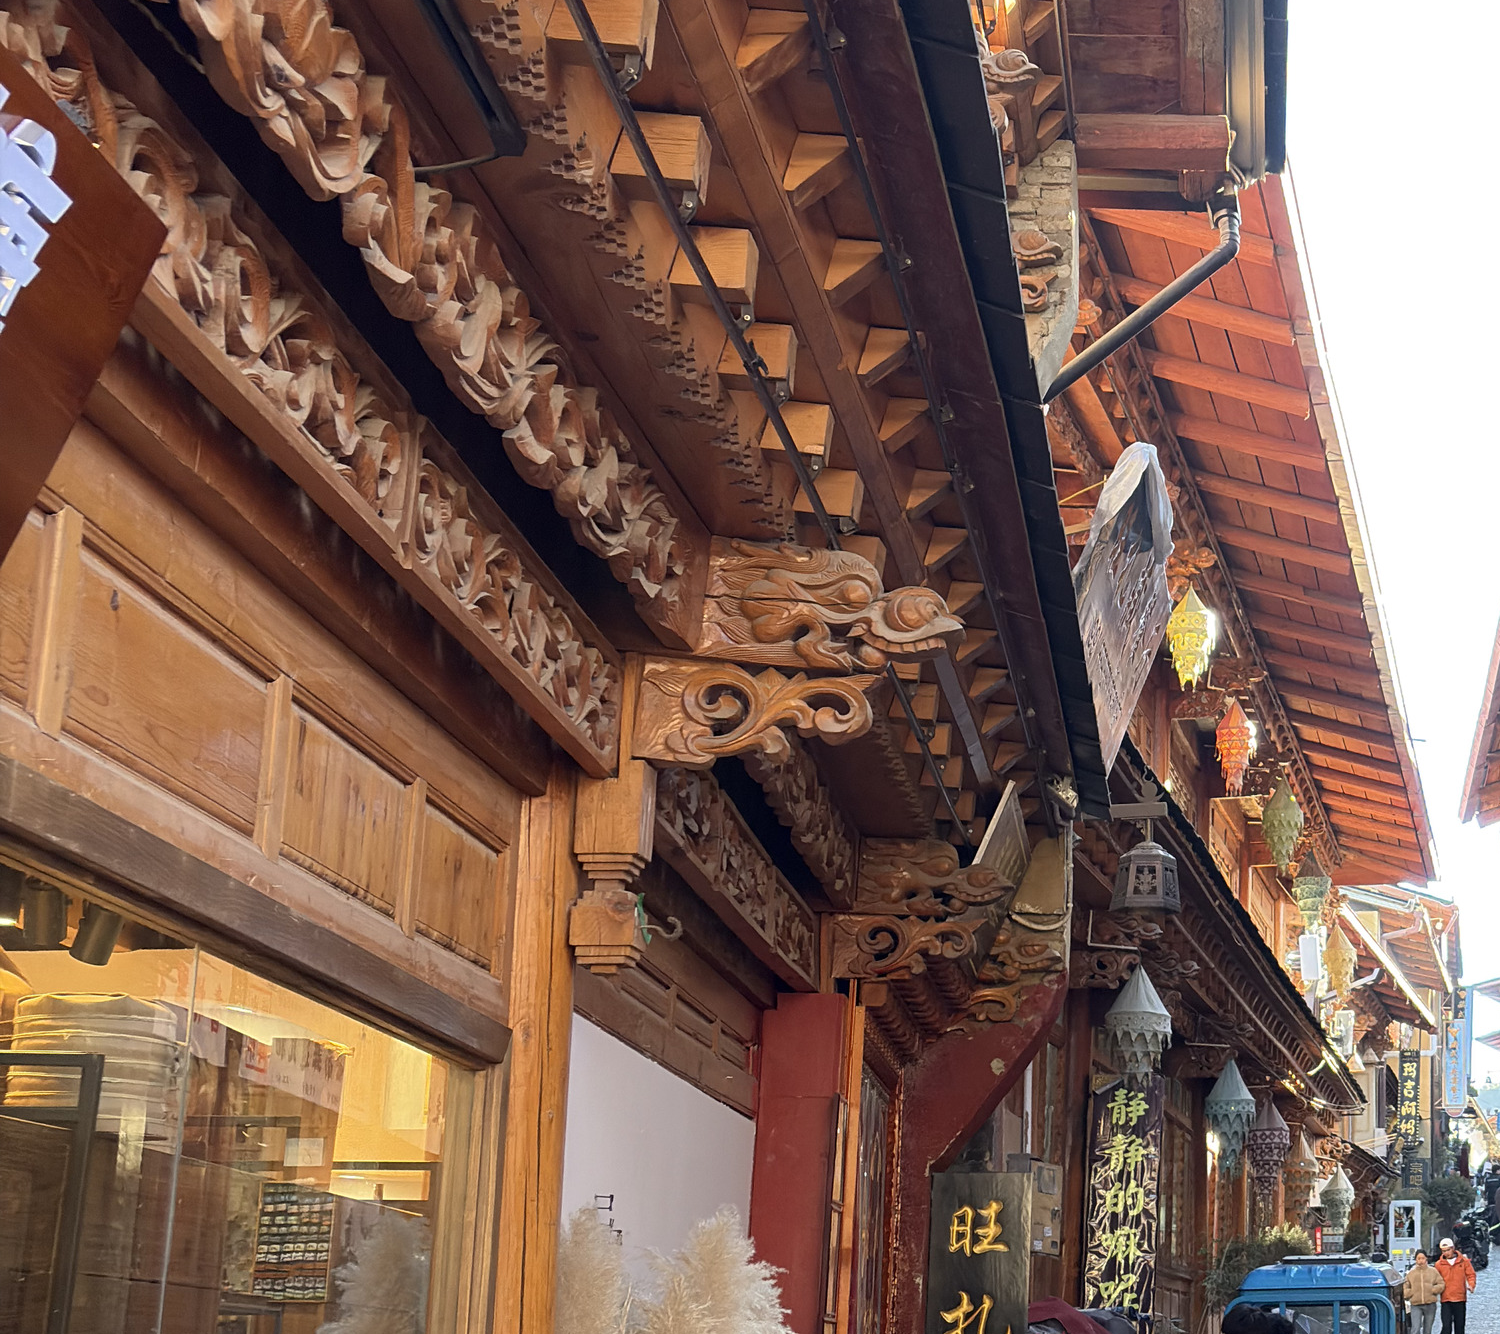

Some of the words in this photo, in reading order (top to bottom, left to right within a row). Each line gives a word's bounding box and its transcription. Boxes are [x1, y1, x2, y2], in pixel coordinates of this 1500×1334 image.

[1400, 1062, 1417, 1135] 玛吉阿妈
[1409, 1162, 1423, 1190] 宗吧
